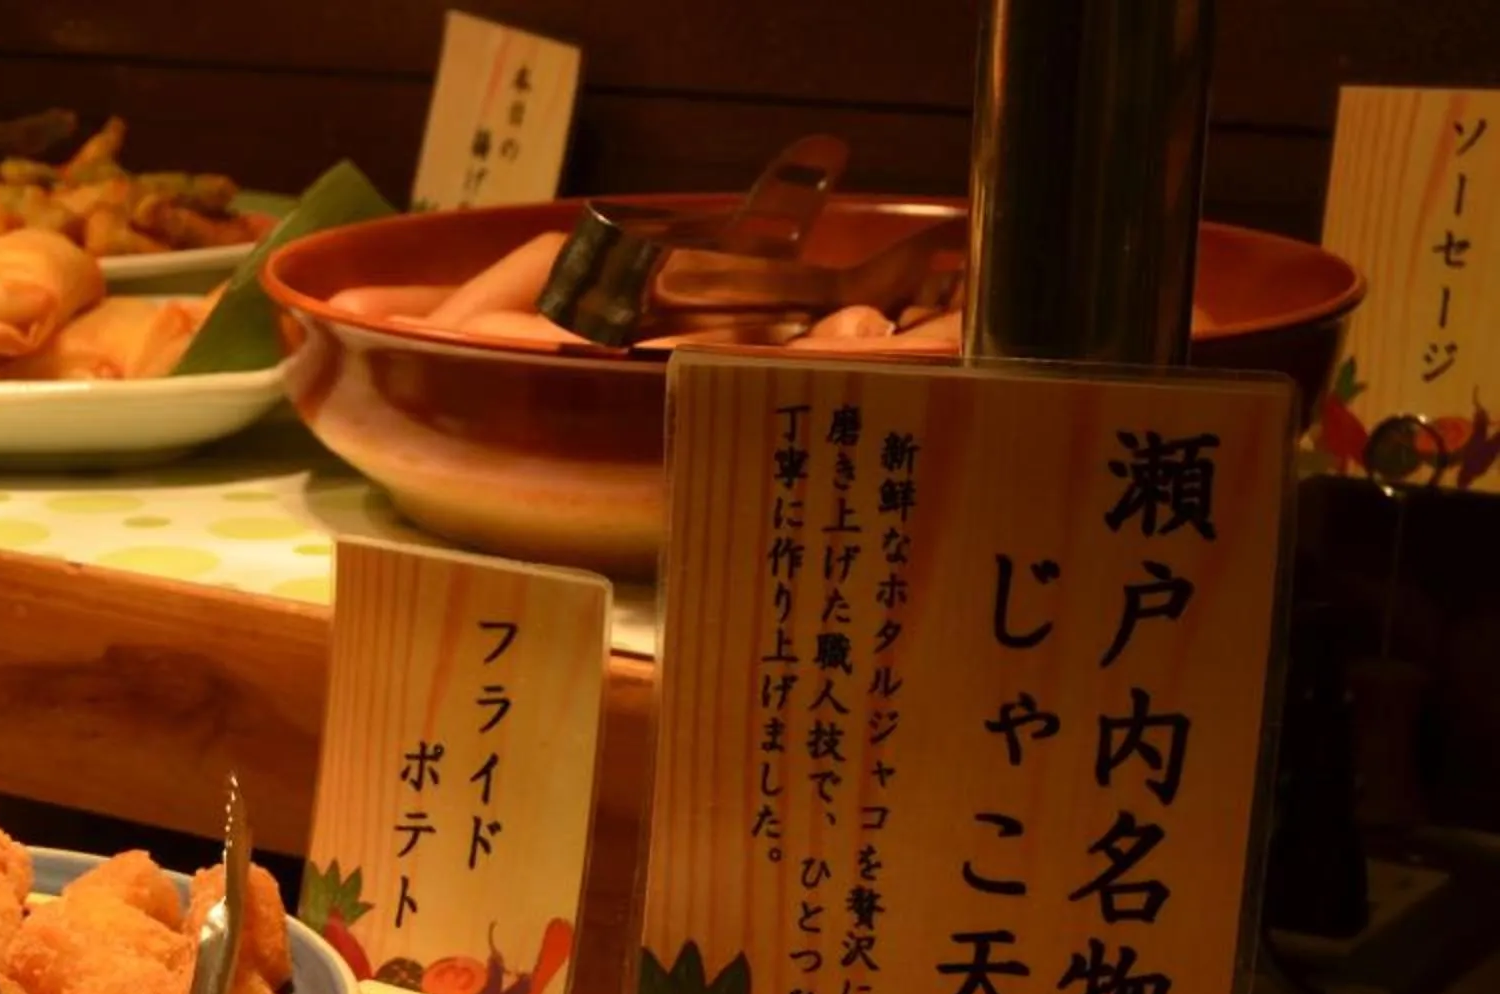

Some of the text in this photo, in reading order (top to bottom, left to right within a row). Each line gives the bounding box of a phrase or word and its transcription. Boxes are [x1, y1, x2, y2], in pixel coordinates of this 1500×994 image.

[1422, 118, 1487, 383] ソーセージ
[468, 620, 518, 870] フライド
[751, 405, 811, 864] 丁寧に作り上げました。
[393, 740, 444, 928] ポテト
